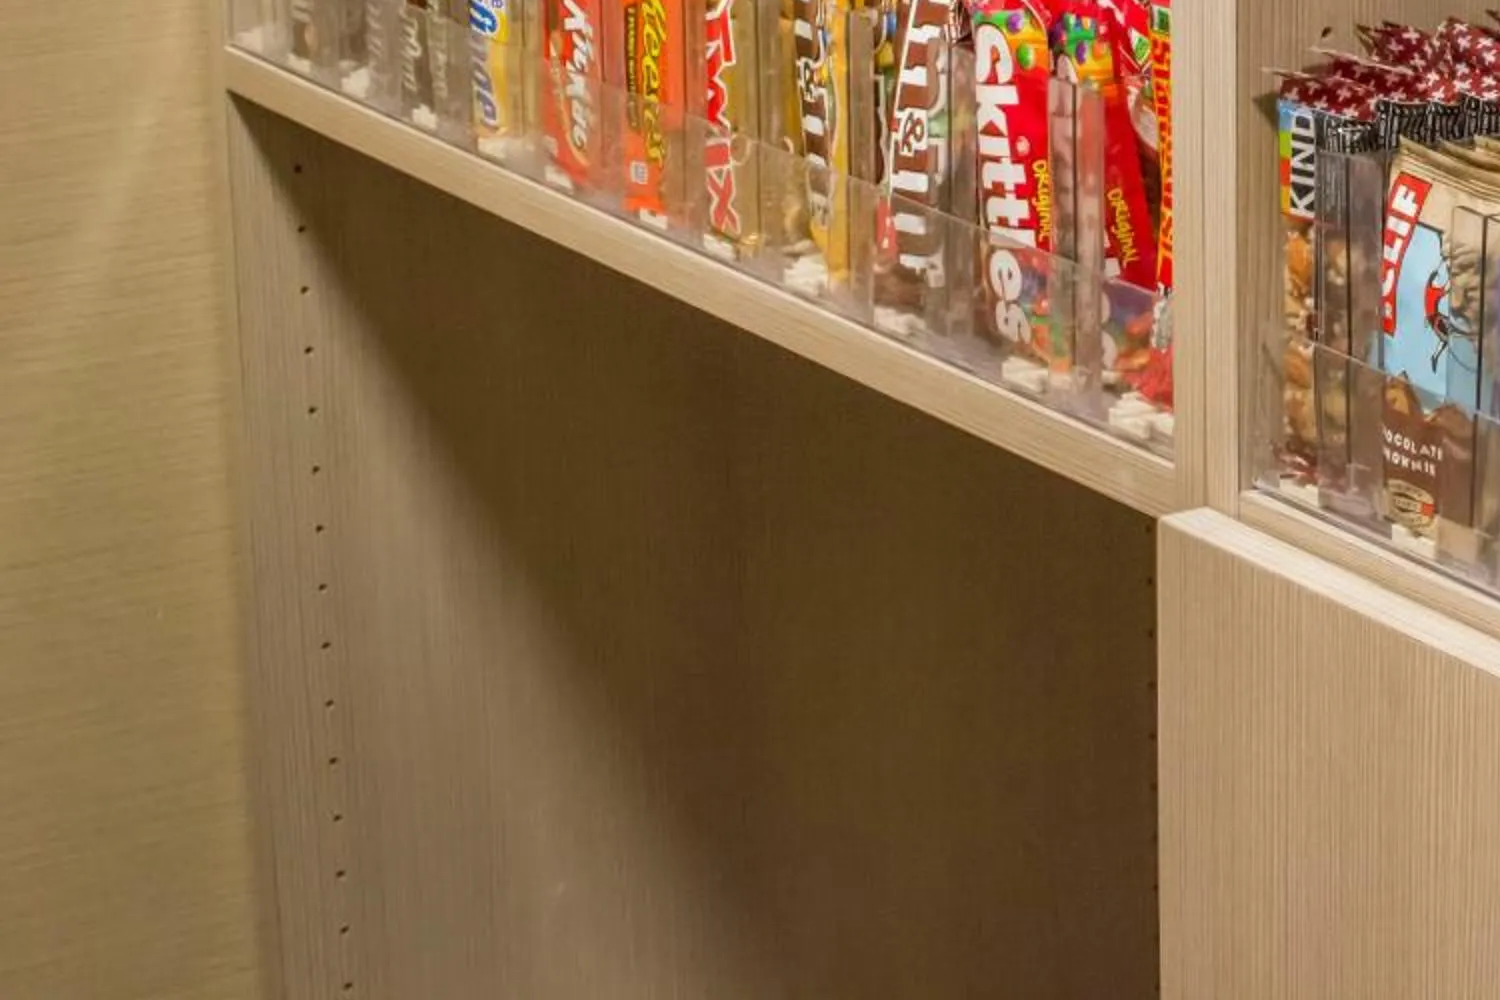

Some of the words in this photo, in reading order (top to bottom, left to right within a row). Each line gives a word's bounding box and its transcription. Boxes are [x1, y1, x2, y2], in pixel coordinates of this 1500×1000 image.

[974, 24, 1036, 344] Skittles
[1289, 107, 1316, 219] KIND
[1382, 425, 1443, 461] OCOLATE
